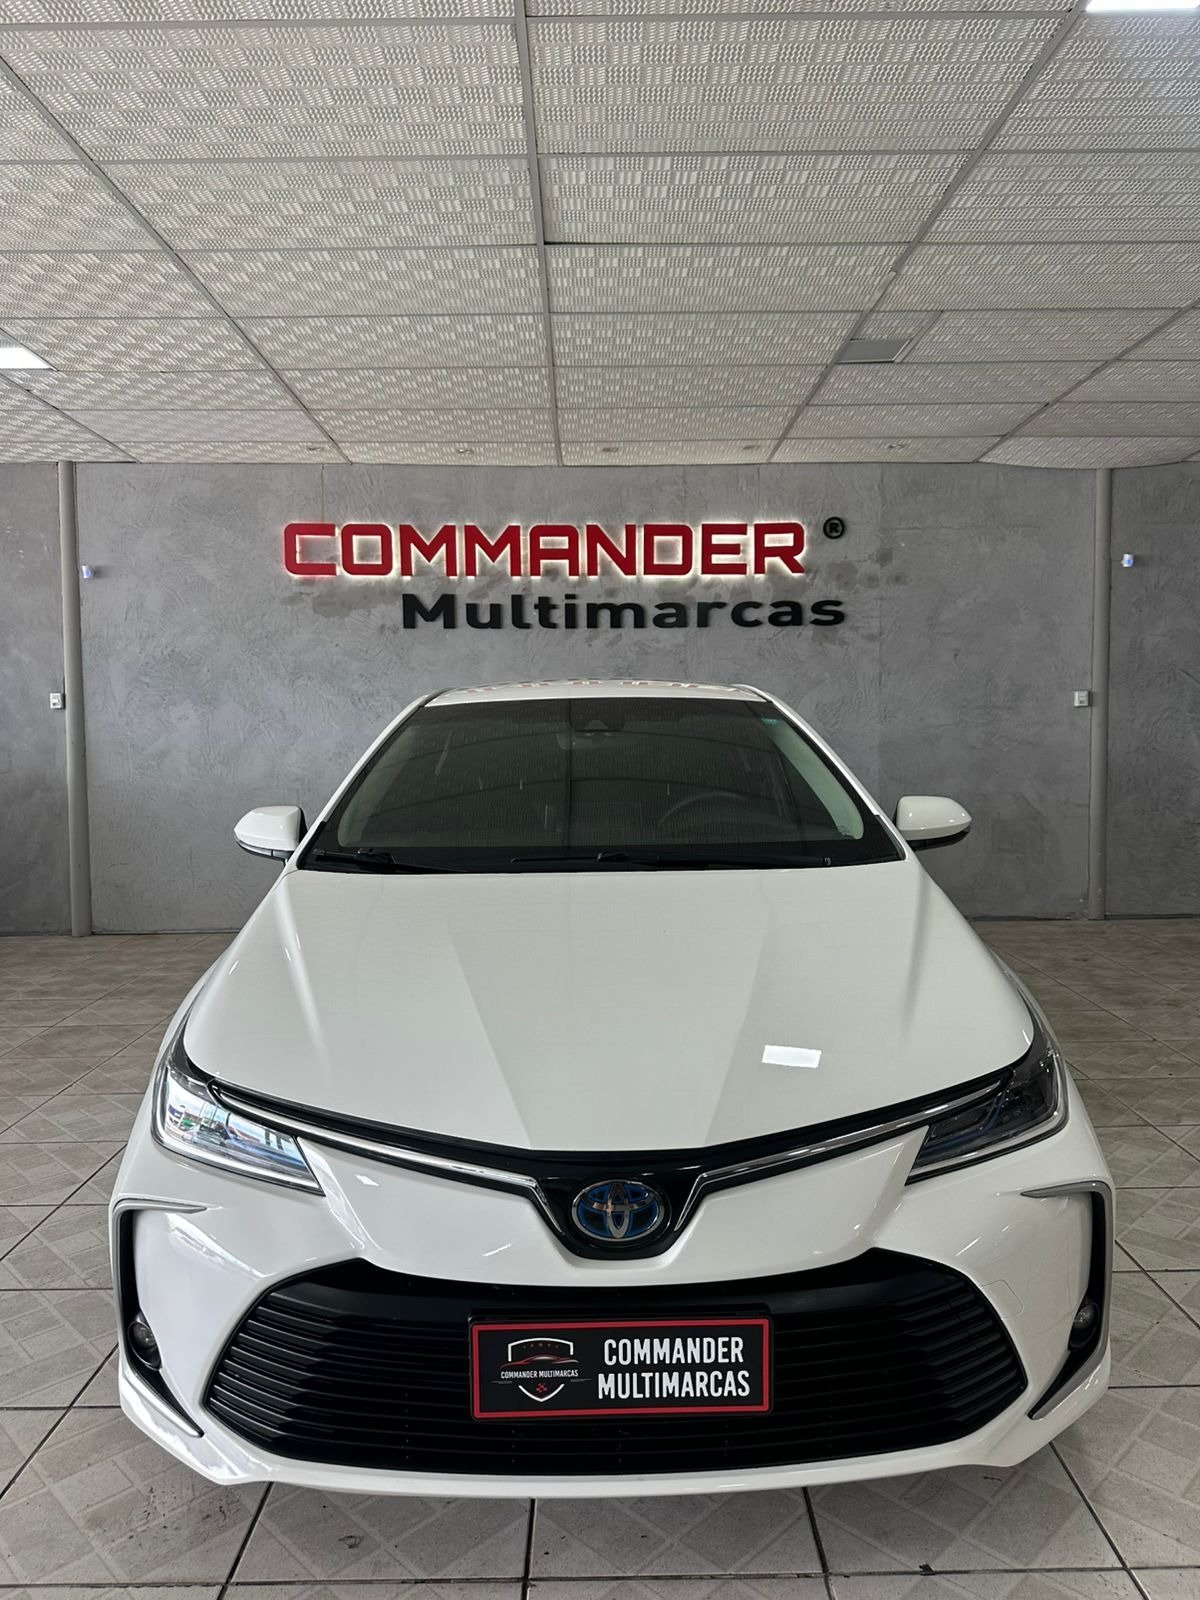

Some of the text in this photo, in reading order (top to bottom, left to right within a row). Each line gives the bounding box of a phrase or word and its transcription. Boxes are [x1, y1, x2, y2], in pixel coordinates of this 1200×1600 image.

[284, 522, 806, 577] COMMANDER
[402, 593, 845, 629] Multimarcas
[604, 1337, 744, 1365] COMMANDER
[501, 1371, 537, 1379] COMMANDER
[598, 1371, 750, 1399] MULTIMARCAS
